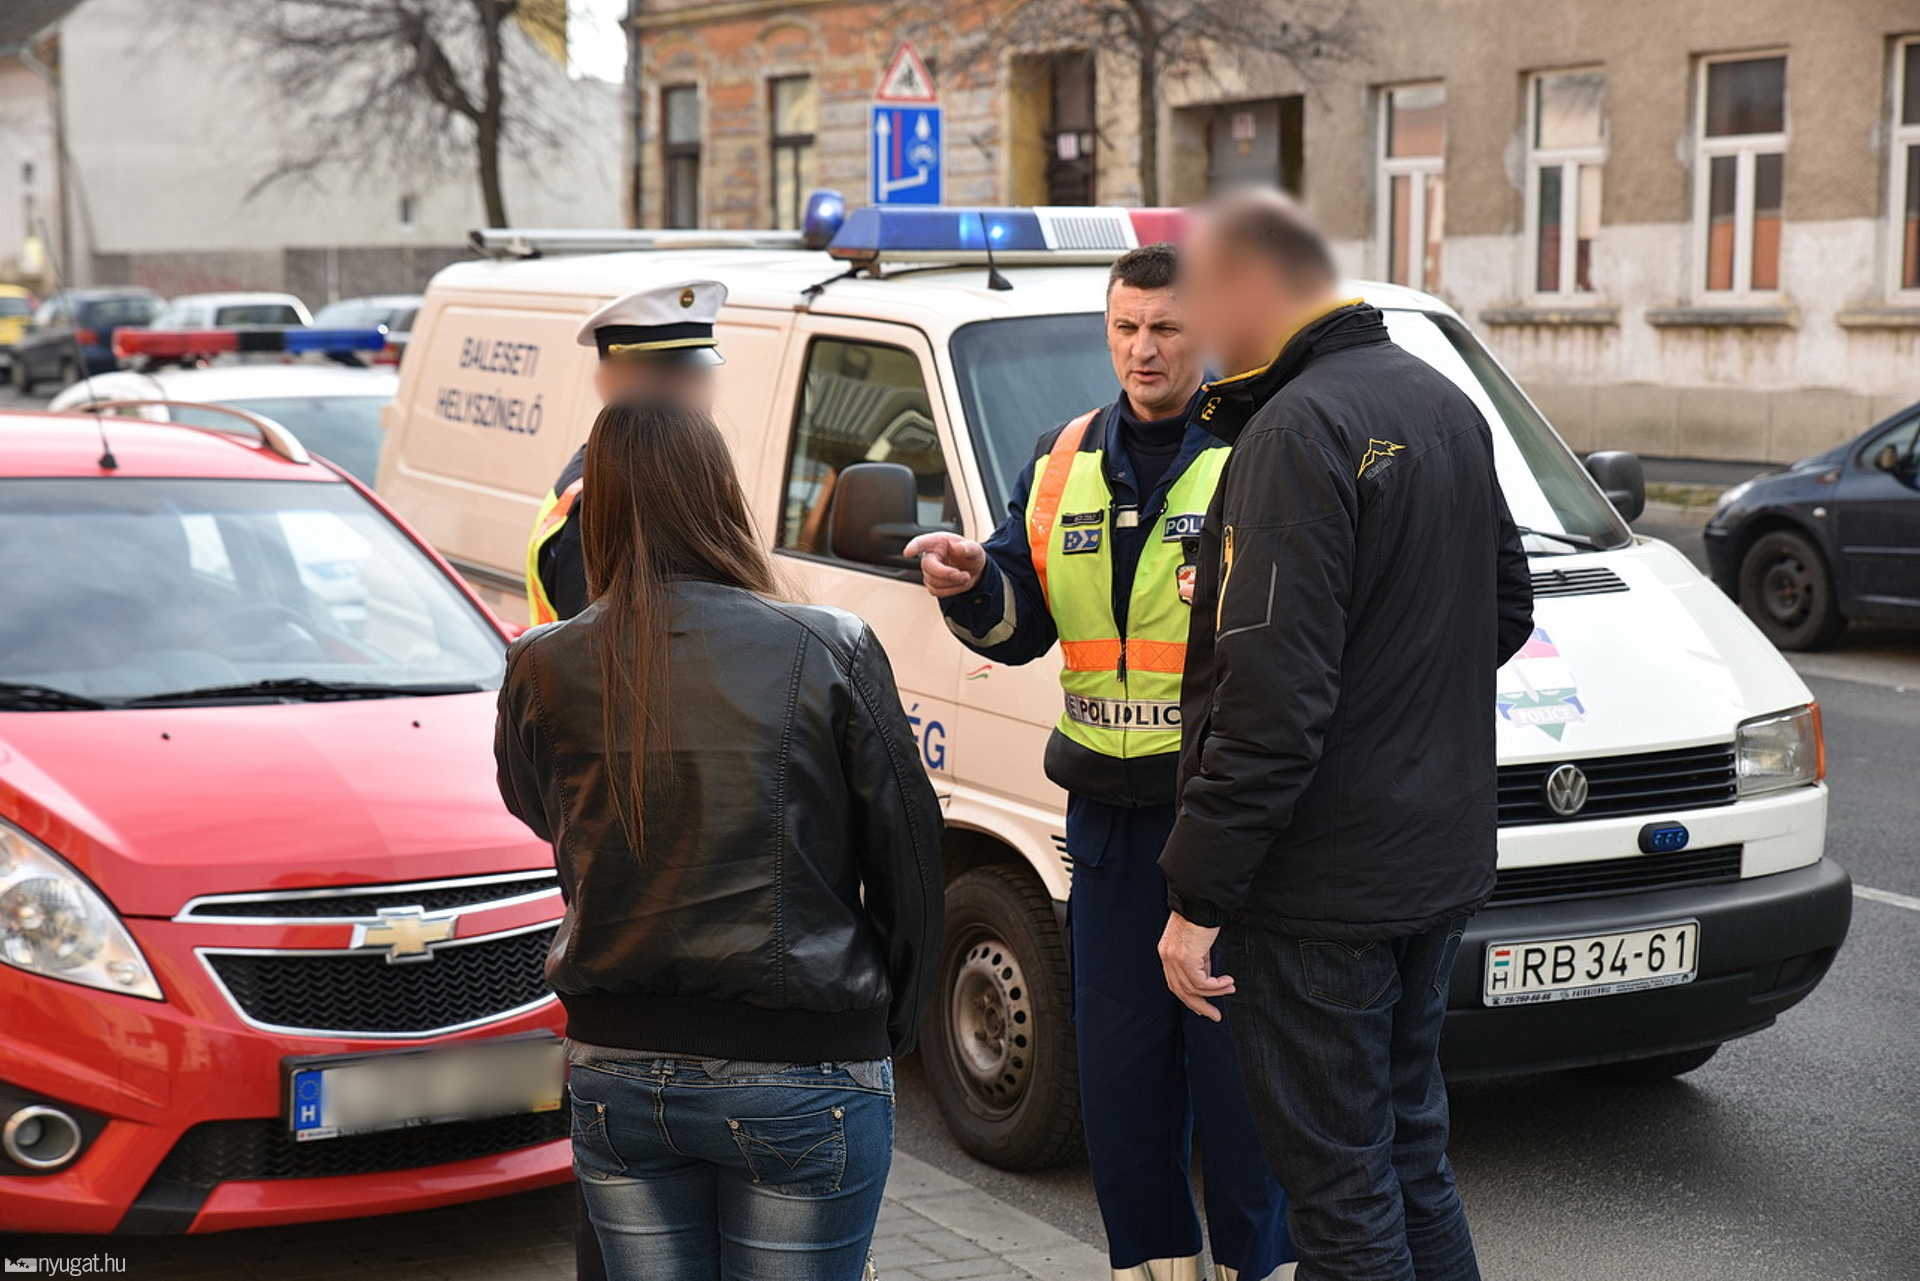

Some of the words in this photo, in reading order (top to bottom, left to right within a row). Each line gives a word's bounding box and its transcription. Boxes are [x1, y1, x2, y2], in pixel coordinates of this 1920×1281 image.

[460, 337, 541, 377] BALESETI
[1492, 971, 1508, 990] H
[301, 1104, 316, 1123] H
